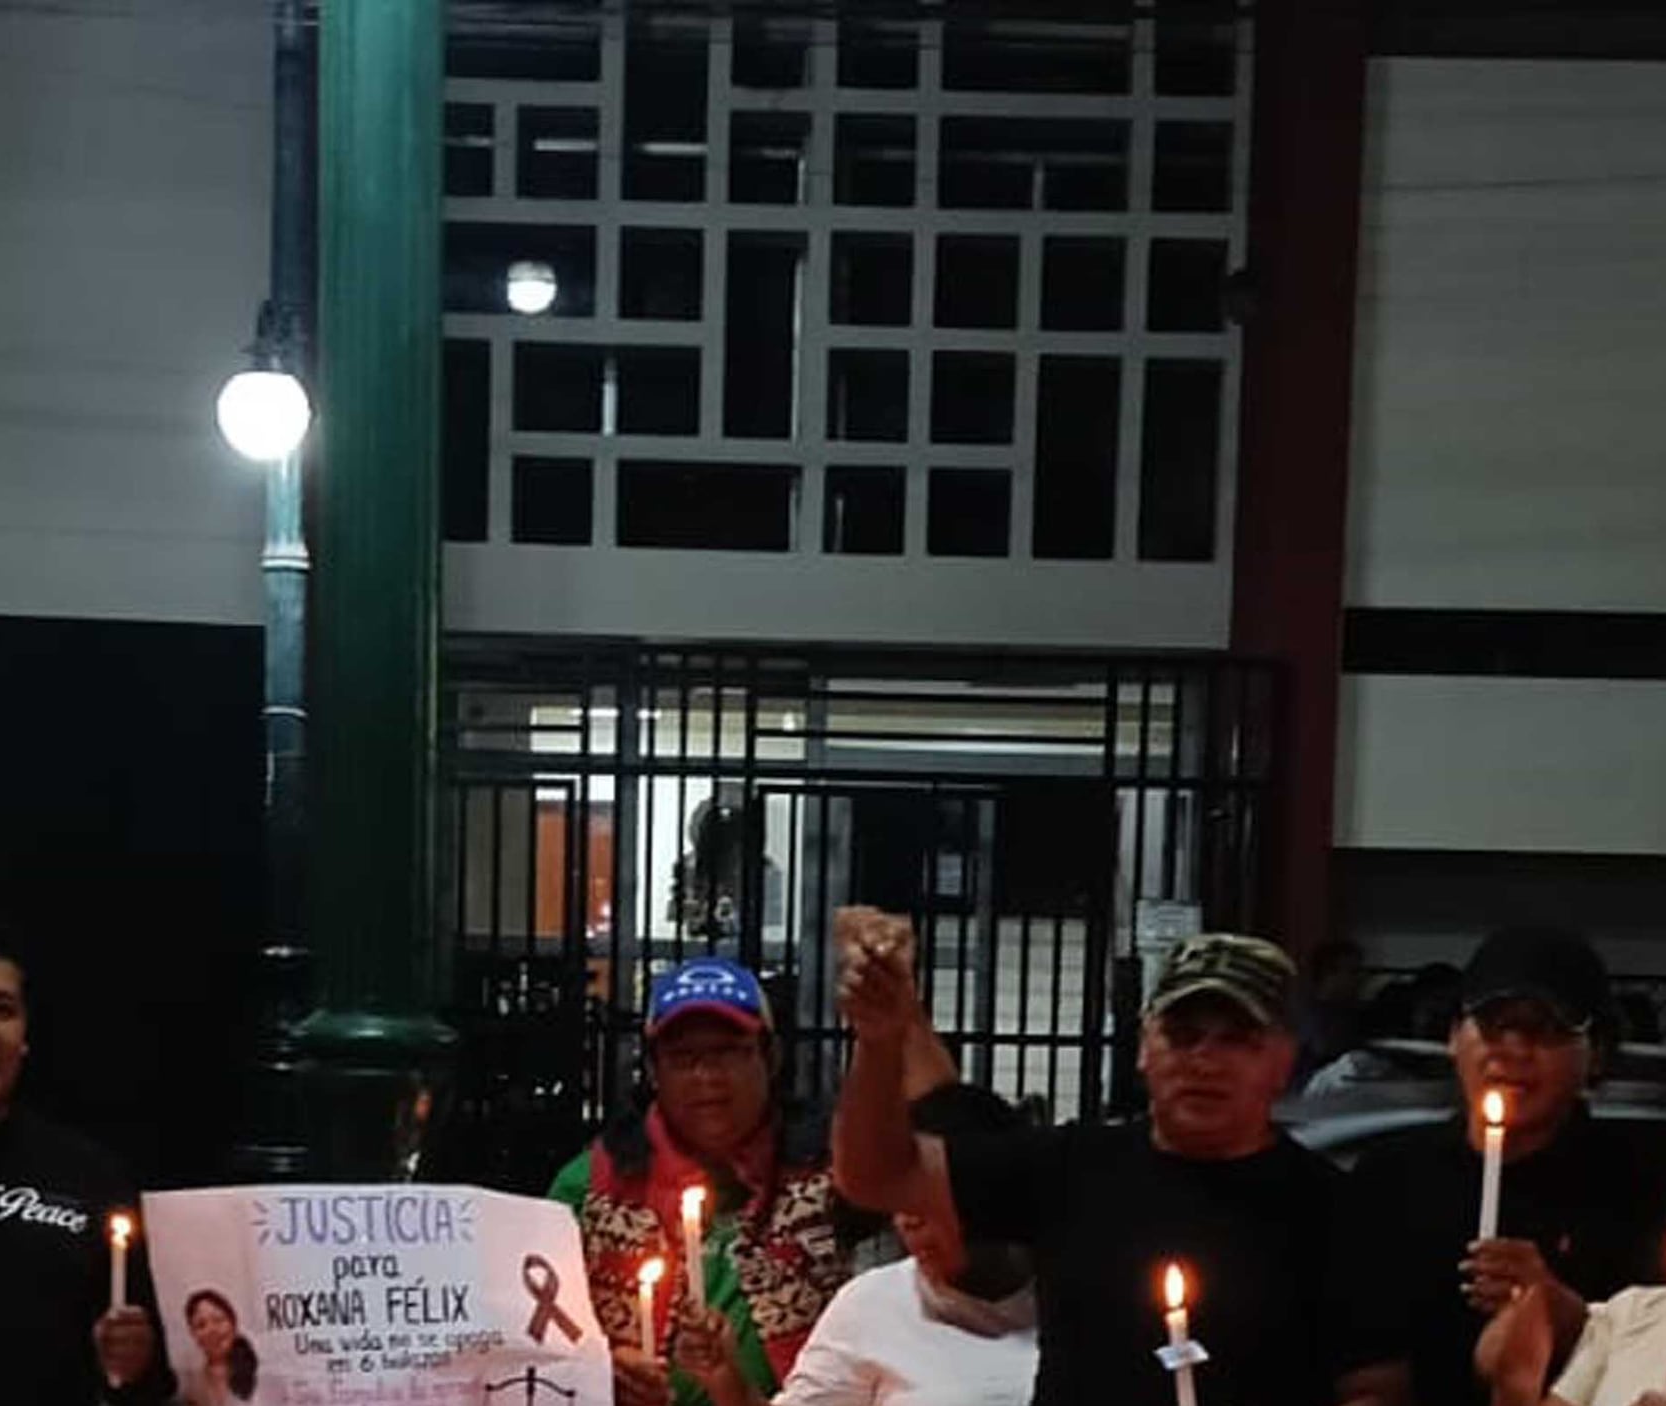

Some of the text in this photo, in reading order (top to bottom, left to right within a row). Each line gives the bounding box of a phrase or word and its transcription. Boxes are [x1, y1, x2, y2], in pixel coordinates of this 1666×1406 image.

[277, 1192, 454, 1246] JUSTICIA
[333, 1254, 401, 1289] para
[266, 1276, 469, 1330] ROXANA FÉLIX
[339, 1328, 382, 1351] vida
